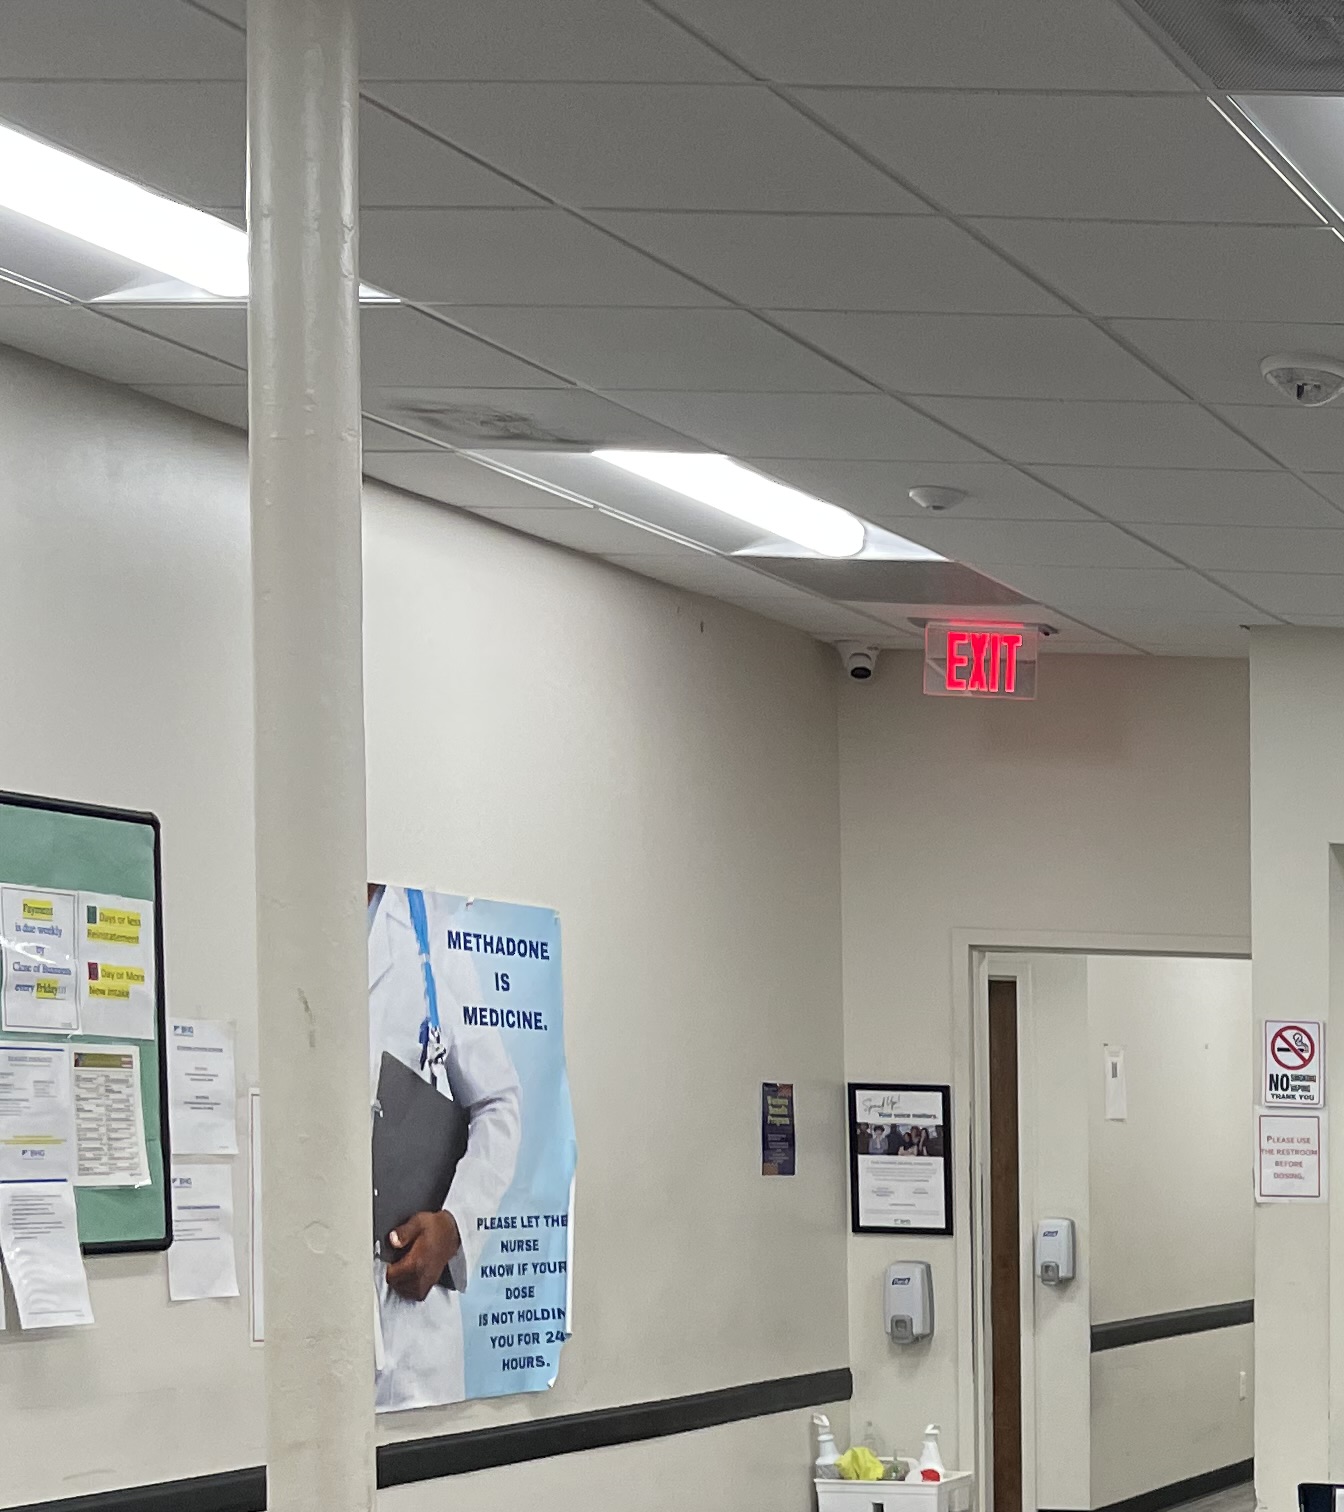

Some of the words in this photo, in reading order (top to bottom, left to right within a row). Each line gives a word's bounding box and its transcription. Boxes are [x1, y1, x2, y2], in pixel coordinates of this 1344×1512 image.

[946, 632, 1023, 692] EXIT
[447, 930, 550, 960] METHADONE
[12, 962, 32, 973] Close
[494, 972, 510, 992] IS
[463, 1006, 548, 1031] MEDICINE.
[1269, 1074, 1290, 1092] NO
[476, 1216, 517, 1231] PLEASE
[520, 1215, 540, 1228] LET
[544, 1214, 568, 1228] THE
[500, 1240, 540, 1253] NURSE
[480, 1264, 514, 1278] KNOW
[518, 1262, 528, 1276] IF
[506, 1286, 535, 1300] DOSE
[478, 1314, 488, 1326] IS
[491, 1311, 514, 1324] NOT
[518, 1308, 566, 1322] HOLDIN
[490, 1336, 514, 1349] YOU
[518, 1332, 540, 1346] FOR
[502, 1356, 550, 1371] HOURS.
